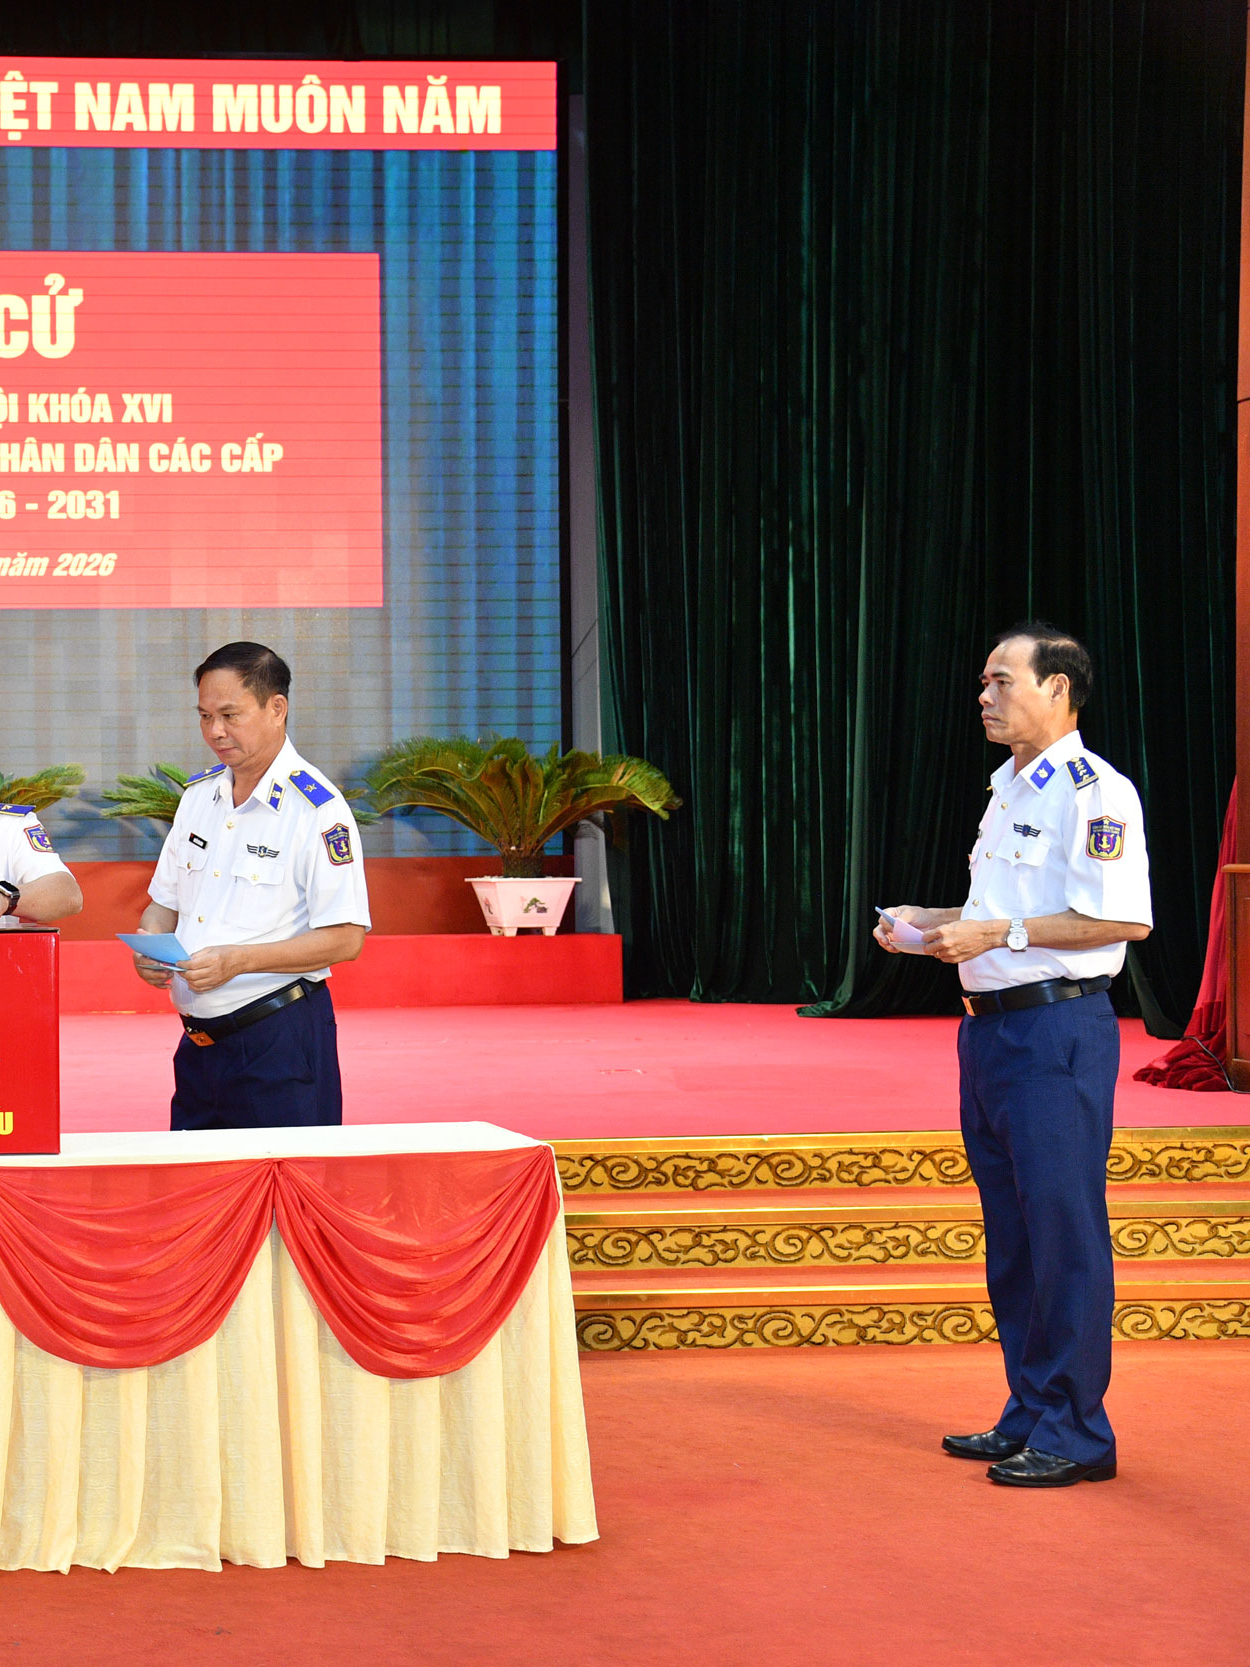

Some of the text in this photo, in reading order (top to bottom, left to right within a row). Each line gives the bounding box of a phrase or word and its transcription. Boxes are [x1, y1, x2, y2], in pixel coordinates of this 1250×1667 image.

[75, 83, 194, 131] NAM
[213, 75, 365, 133] MUÔN
[383, 76, 501, 133] NĂM
[28, 387, 113, 422] KHÓA
[122, 394, 172, 422] XVI
[74, 437, 139, 472] DÂN
[149, 437, 211, 472] CÁC
[221, 433, 283, 472] CẤP
[48, 490, 119, 519] 2031
[53, 553, 117, 576] 2026
